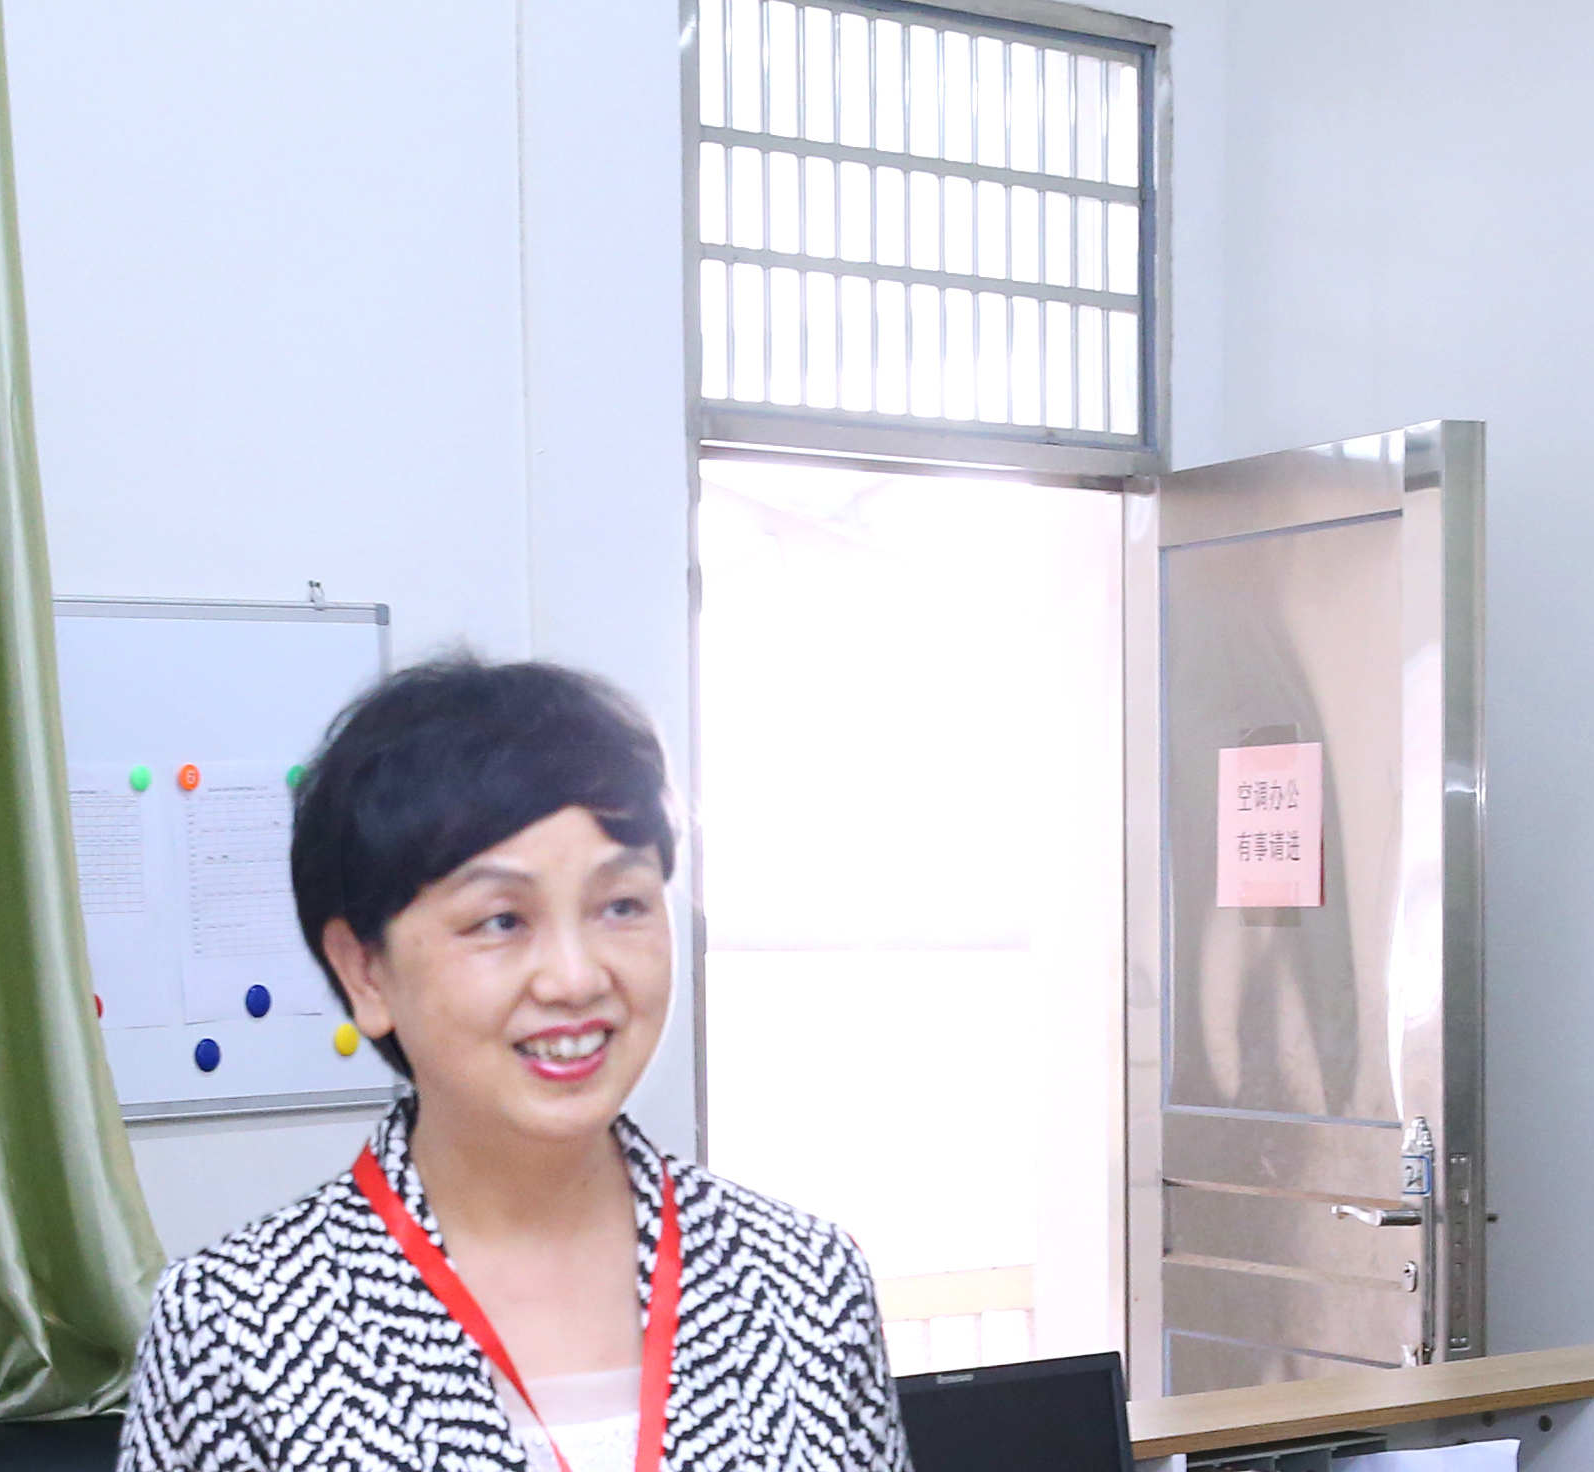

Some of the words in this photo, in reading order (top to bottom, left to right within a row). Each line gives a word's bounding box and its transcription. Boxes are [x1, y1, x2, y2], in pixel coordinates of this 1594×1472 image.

[1236, 778, 1301, 812] 空调办公
[1235, 829, 1302, 862] 有事请进
